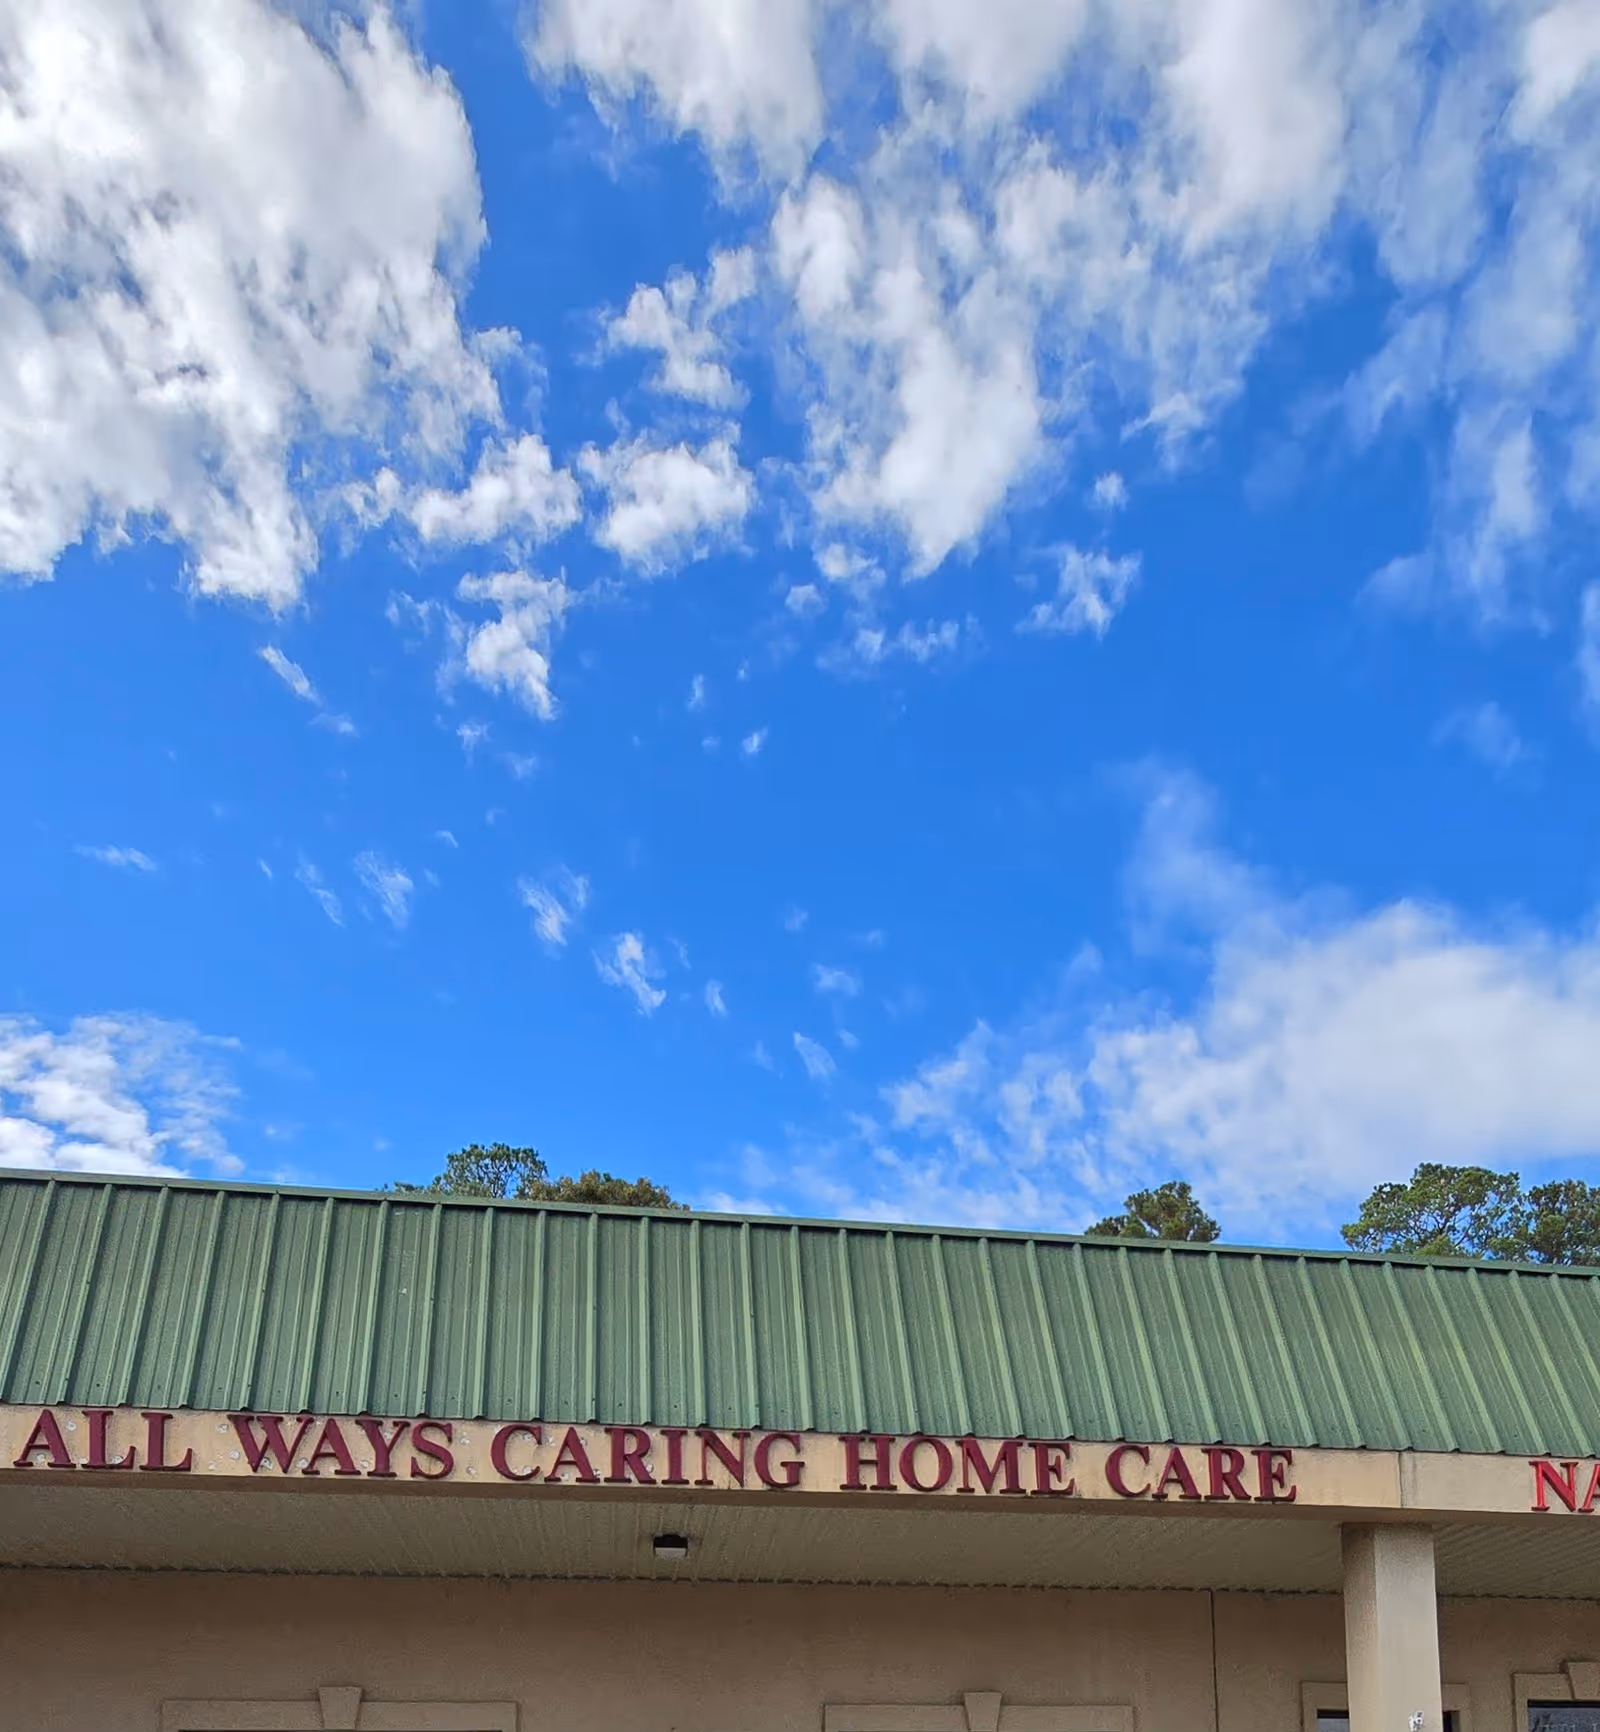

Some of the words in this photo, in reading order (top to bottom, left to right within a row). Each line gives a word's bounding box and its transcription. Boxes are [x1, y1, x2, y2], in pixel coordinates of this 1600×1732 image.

[13, 1409, 192, 1471] ALL
[228, 1414, 454, 1479] WAYS
[491, 1424, 805, 1490] CARING
[838, 1435, 1075, 1496] HOME
[1105, 1445, 1297, 1501] CARE
